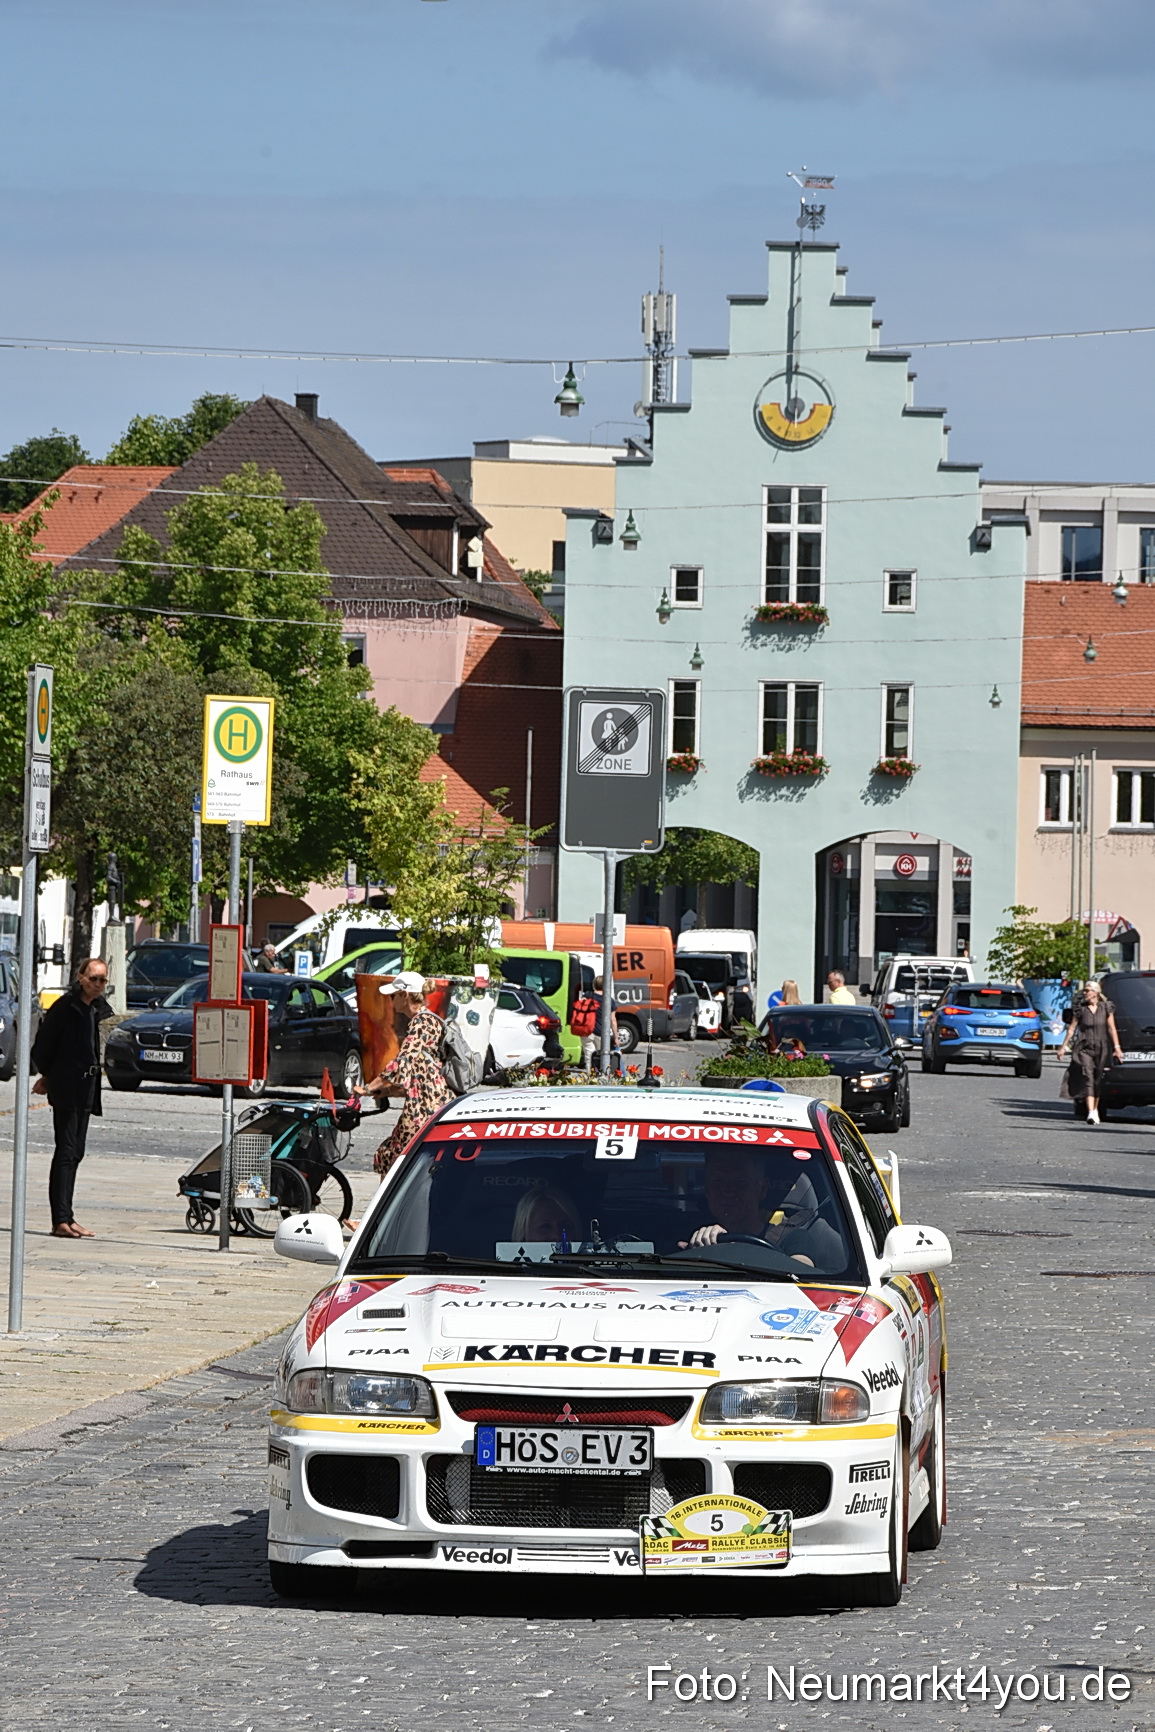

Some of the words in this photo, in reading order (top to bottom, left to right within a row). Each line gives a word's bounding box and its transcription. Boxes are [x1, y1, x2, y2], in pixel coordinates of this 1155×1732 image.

[228, 719, 248, 751] H
[596, 758, 631, 770] ZONE
[220, 770, 253, 779] Rathaus
[144, 1051, 154, 1059] NM
[158, 1052, 168, 1060] MX
[171, 1052, 182, 1060] 93
[485, 1123, 640, 1139] MITSUBISHI
[649, 1125, 758, 1142] MOTORS
[605, 1138, 624, 1156] 5
[441, 1300, 607, 1310] AUTOHAUS
[618, 1303, 728, 1314] MACHT
[348, 1348, 410, 1356] PIAA
[463, 1344, 717, 1369] KÄRCHER
[738, 1355, 803, 1365] PIAA
[861, 1361, 903, 1394] Veedol
[482, 1450, 491, 1459] D
[581, 1434, 623, 1465] EV
[629, 1435, 648, 1465] 3
[848, 1459, 891, 1484] PIRELLI
[683, 1498, 763, 1518] INTERNATIONALE
[844, 1492, 888, 1519] Sebring
[710, 1513, 724, 1532] 5
[644, 1541, 669, 1549] ADAC
[674, 1541, 707, 1551] Metz
[711, 1538, 746, 1547] RALLYE
[749, 1536, 788, 1545] CLASSIC
[440, 1545, 513, 1565] Veedol
